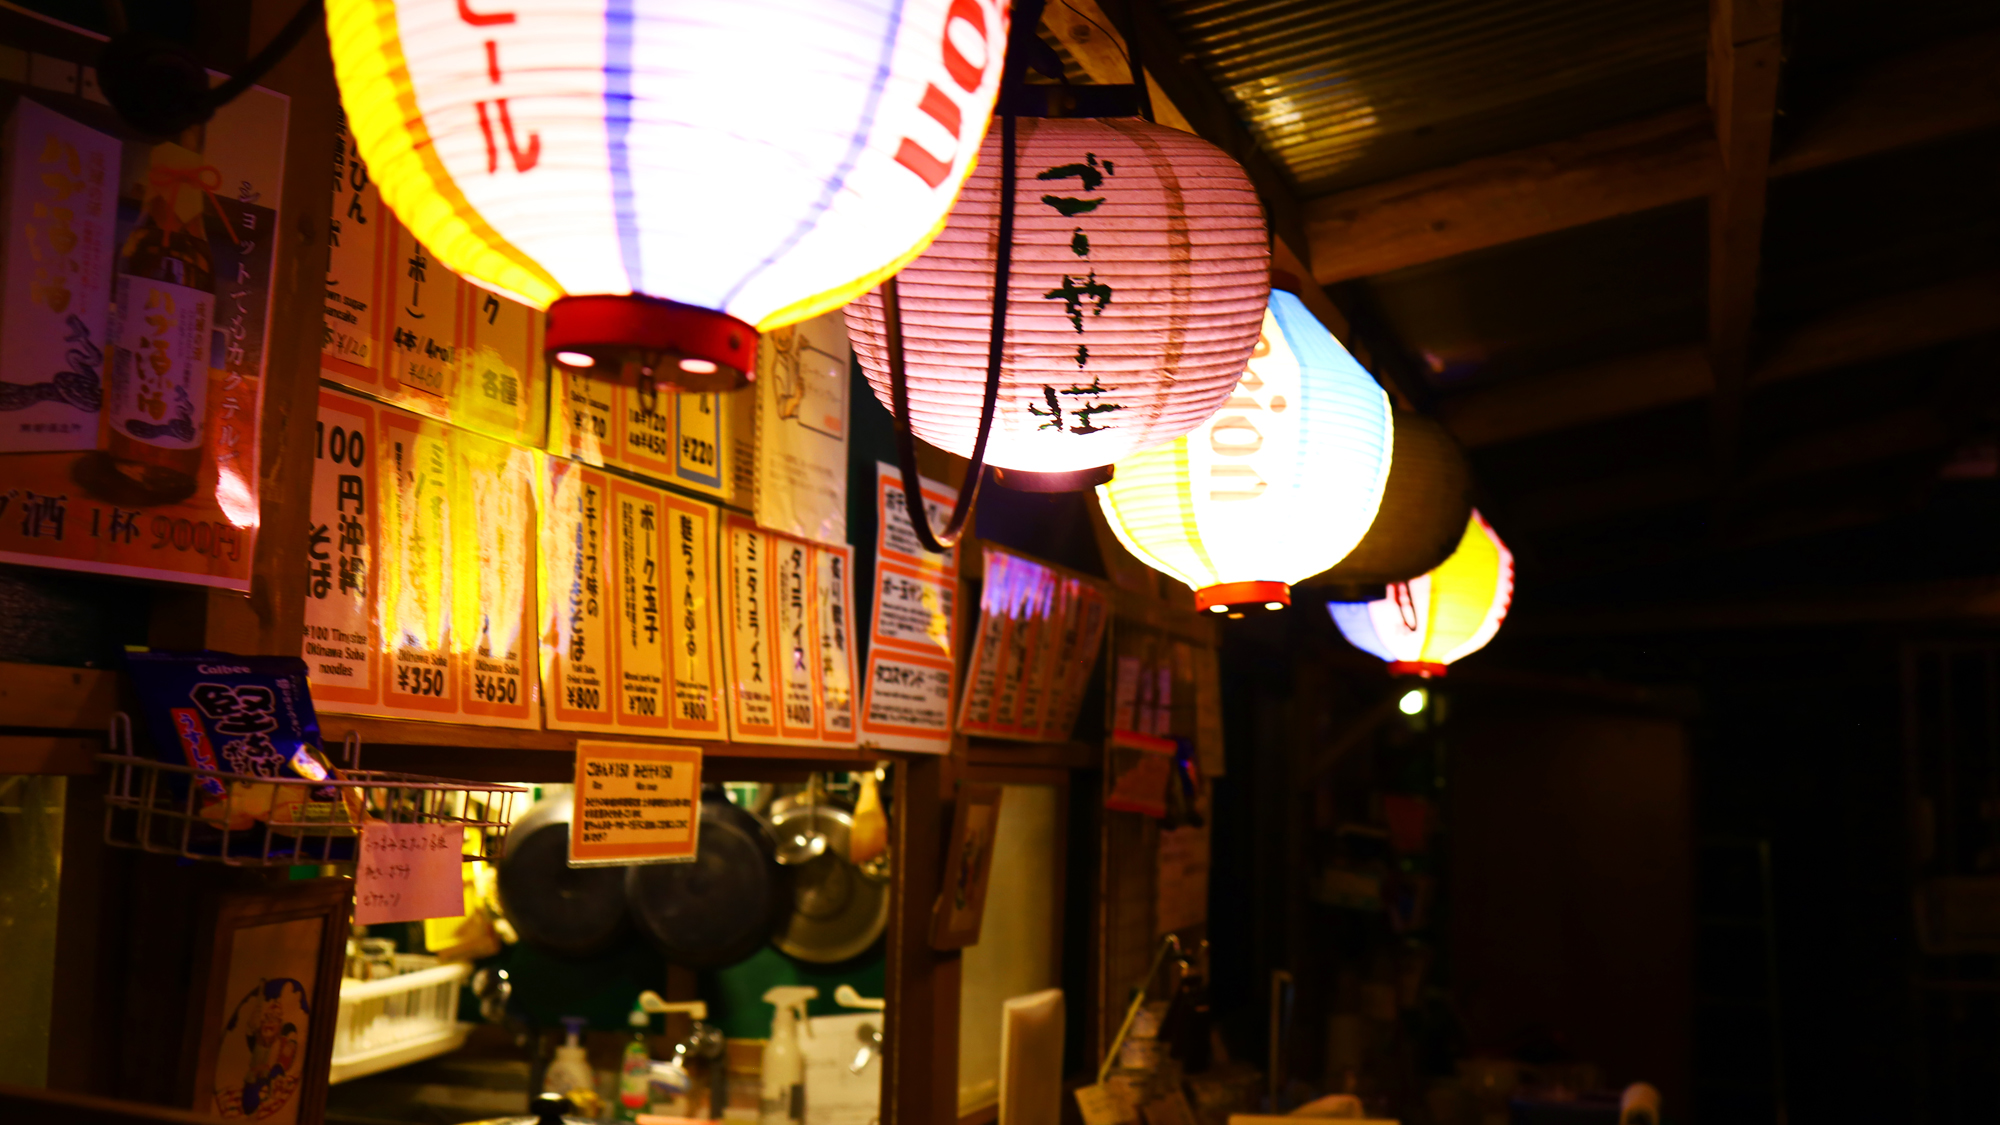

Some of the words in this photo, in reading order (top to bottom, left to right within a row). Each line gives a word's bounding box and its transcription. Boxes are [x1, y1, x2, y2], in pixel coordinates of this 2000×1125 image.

[217, 179, 259, 464] ショットでもカクテル
[639, 503, 658, 644] ポーク玉子
[790, 547, 806, 671] タコライス
[305, 642, 343, 659] Okinawa
[345, 646, 366, 662] Soba
[398, 648, 430, 664] Okinawa
[431, 651, 448, 667] Soba
[196, 663, 252, 676] Calbee
[319, 662, 354, 676] noodles
[397, 664, 444, 697] ¥350
[475, 673, 517, 704] ¥650
[566, 686, 600, 711] ¥800
[628, 694, 656, 716] ¥700
